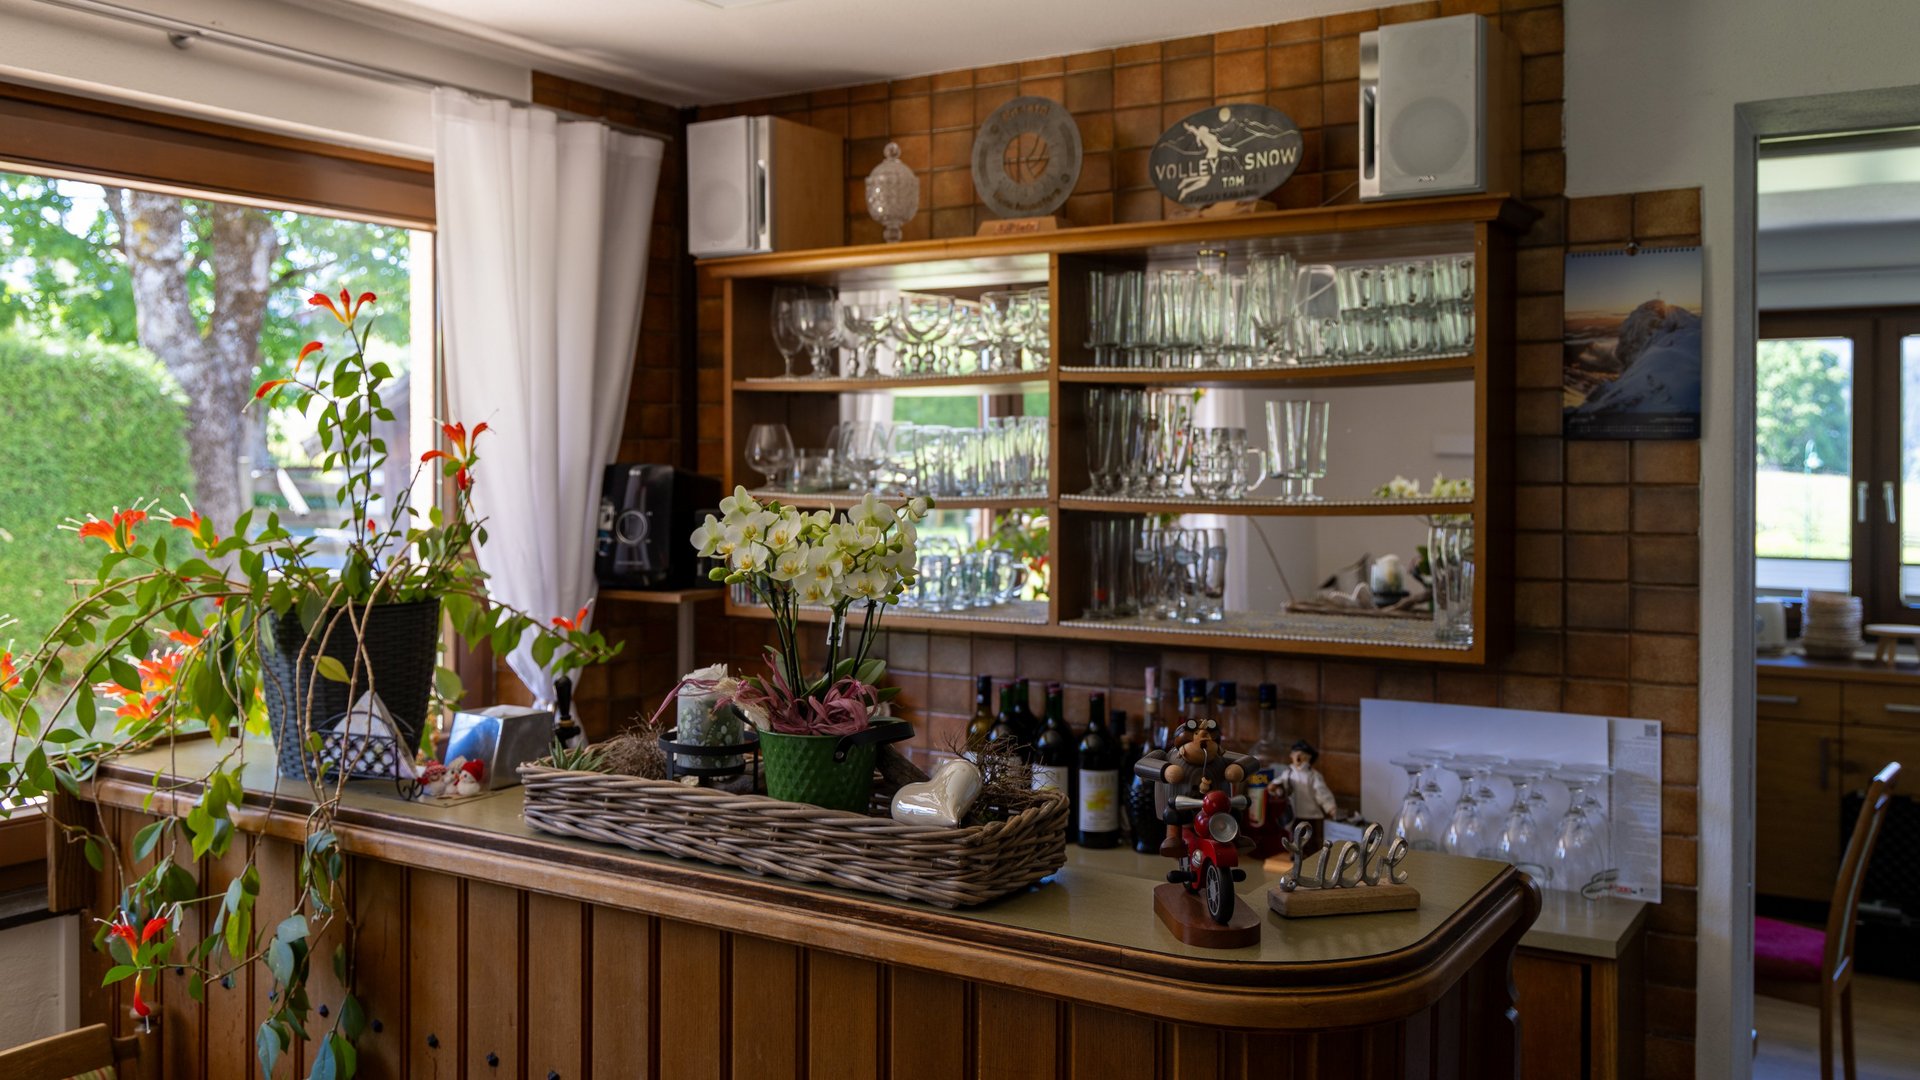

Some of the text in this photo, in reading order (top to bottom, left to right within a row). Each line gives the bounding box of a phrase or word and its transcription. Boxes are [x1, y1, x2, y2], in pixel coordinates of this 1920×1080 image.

[1155, 157, 1219, 180] VOLLEY
[1244, 147, 1297, 171] SNOW
[1221, 176, 1245, 188] TOM
